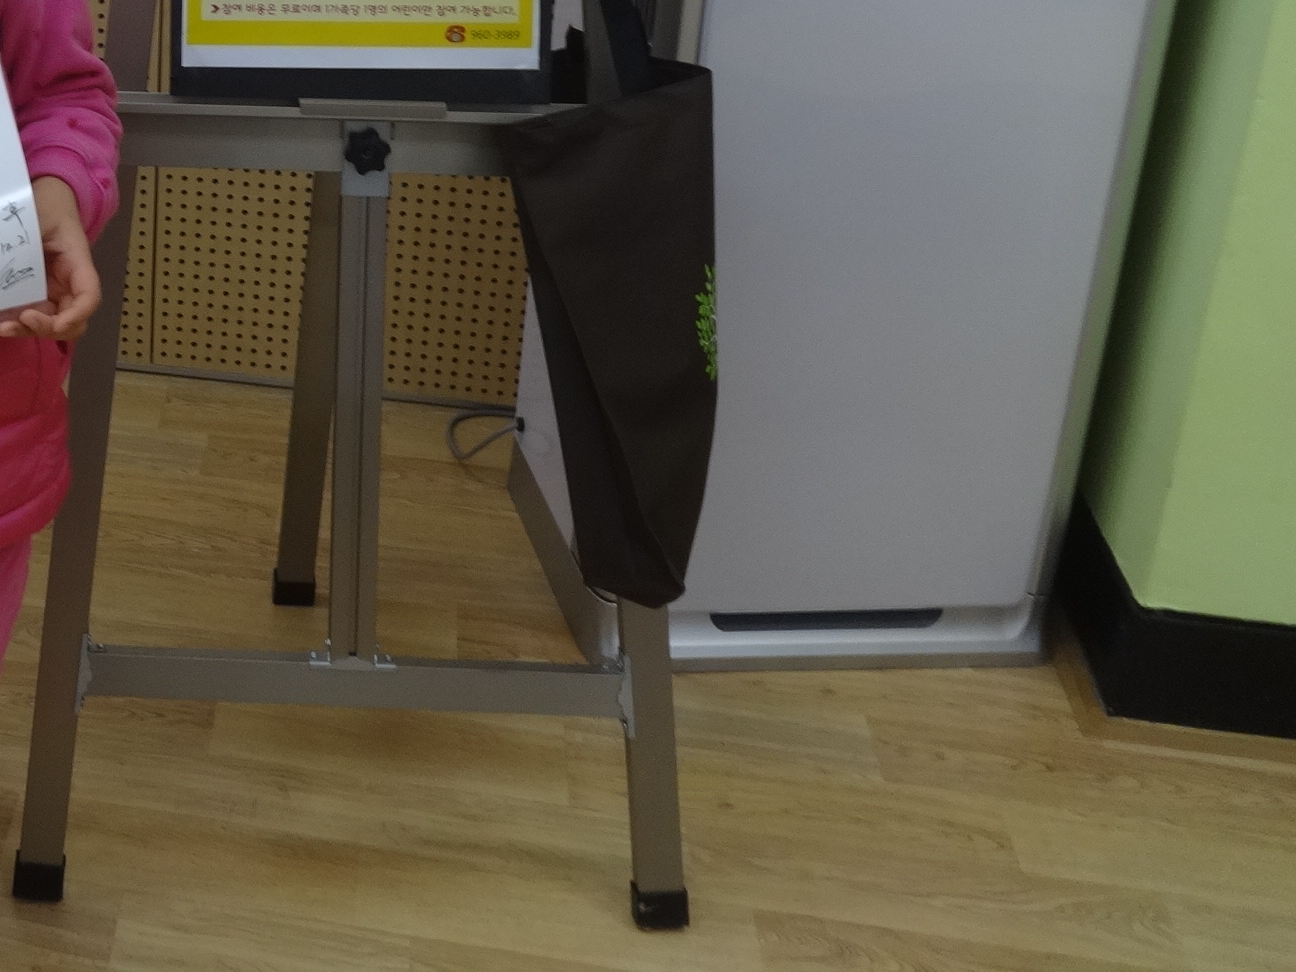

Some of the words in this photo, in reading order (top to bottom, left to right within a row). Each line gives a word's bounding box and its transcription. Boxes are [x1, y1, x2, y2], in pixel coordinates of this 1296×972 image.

[223, 3, 242, 15] 참여
[245, 3, 277, 15] 비용은
[281, 3, 322, 15] 무료이며
[391, 4, 433, 17] 어린이만
[435, 4, 457, 17] 참여
